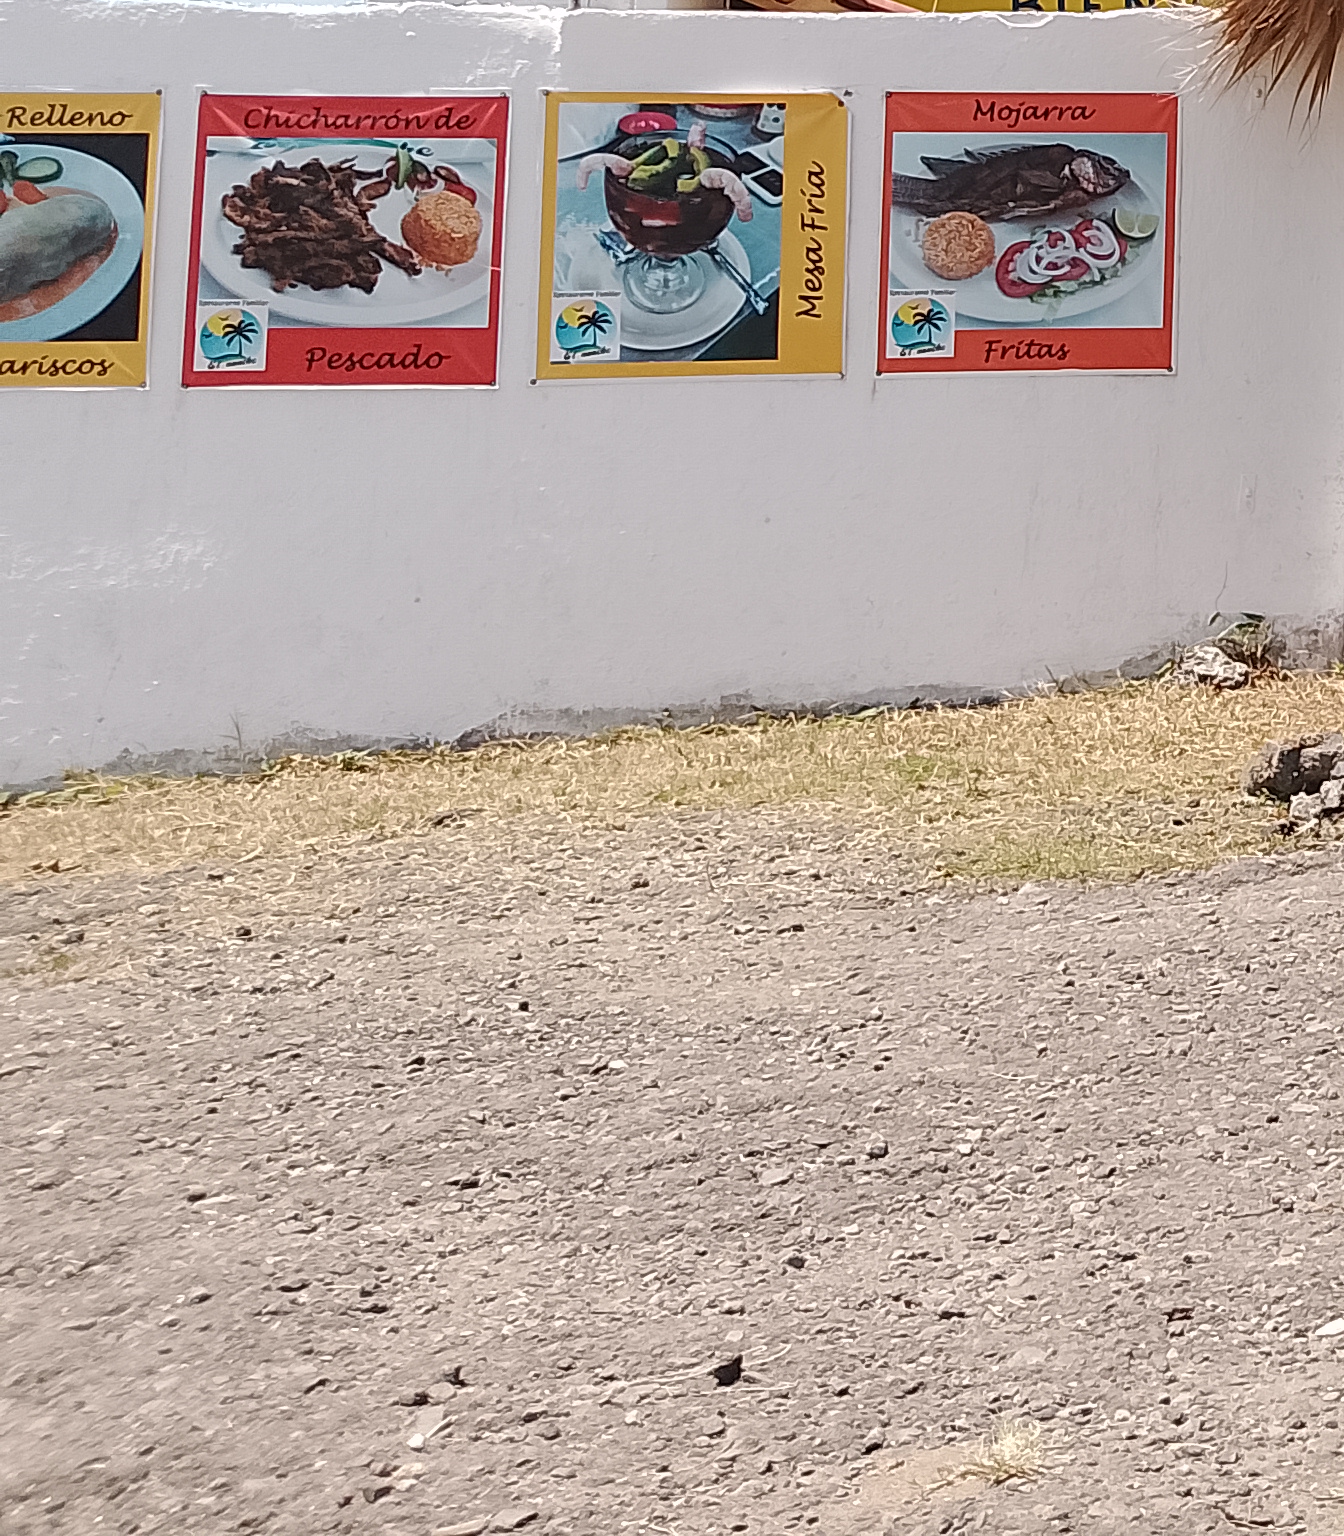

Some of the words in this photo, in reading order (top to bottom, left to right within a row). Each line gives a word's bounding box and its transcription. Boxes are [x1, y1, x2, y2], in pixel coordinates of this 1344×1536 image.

[7, 103, 134, 128] Relleno
[434, 107, 477, 131] de
[972, 99, 1096, 126] Mojarra
[795, 237, 826, 319] Mesa
[305, 345, 450, 373] Pescado
[984, 338, 1070, 363] Fritas
[0, 354, 115, 377] ariscos
